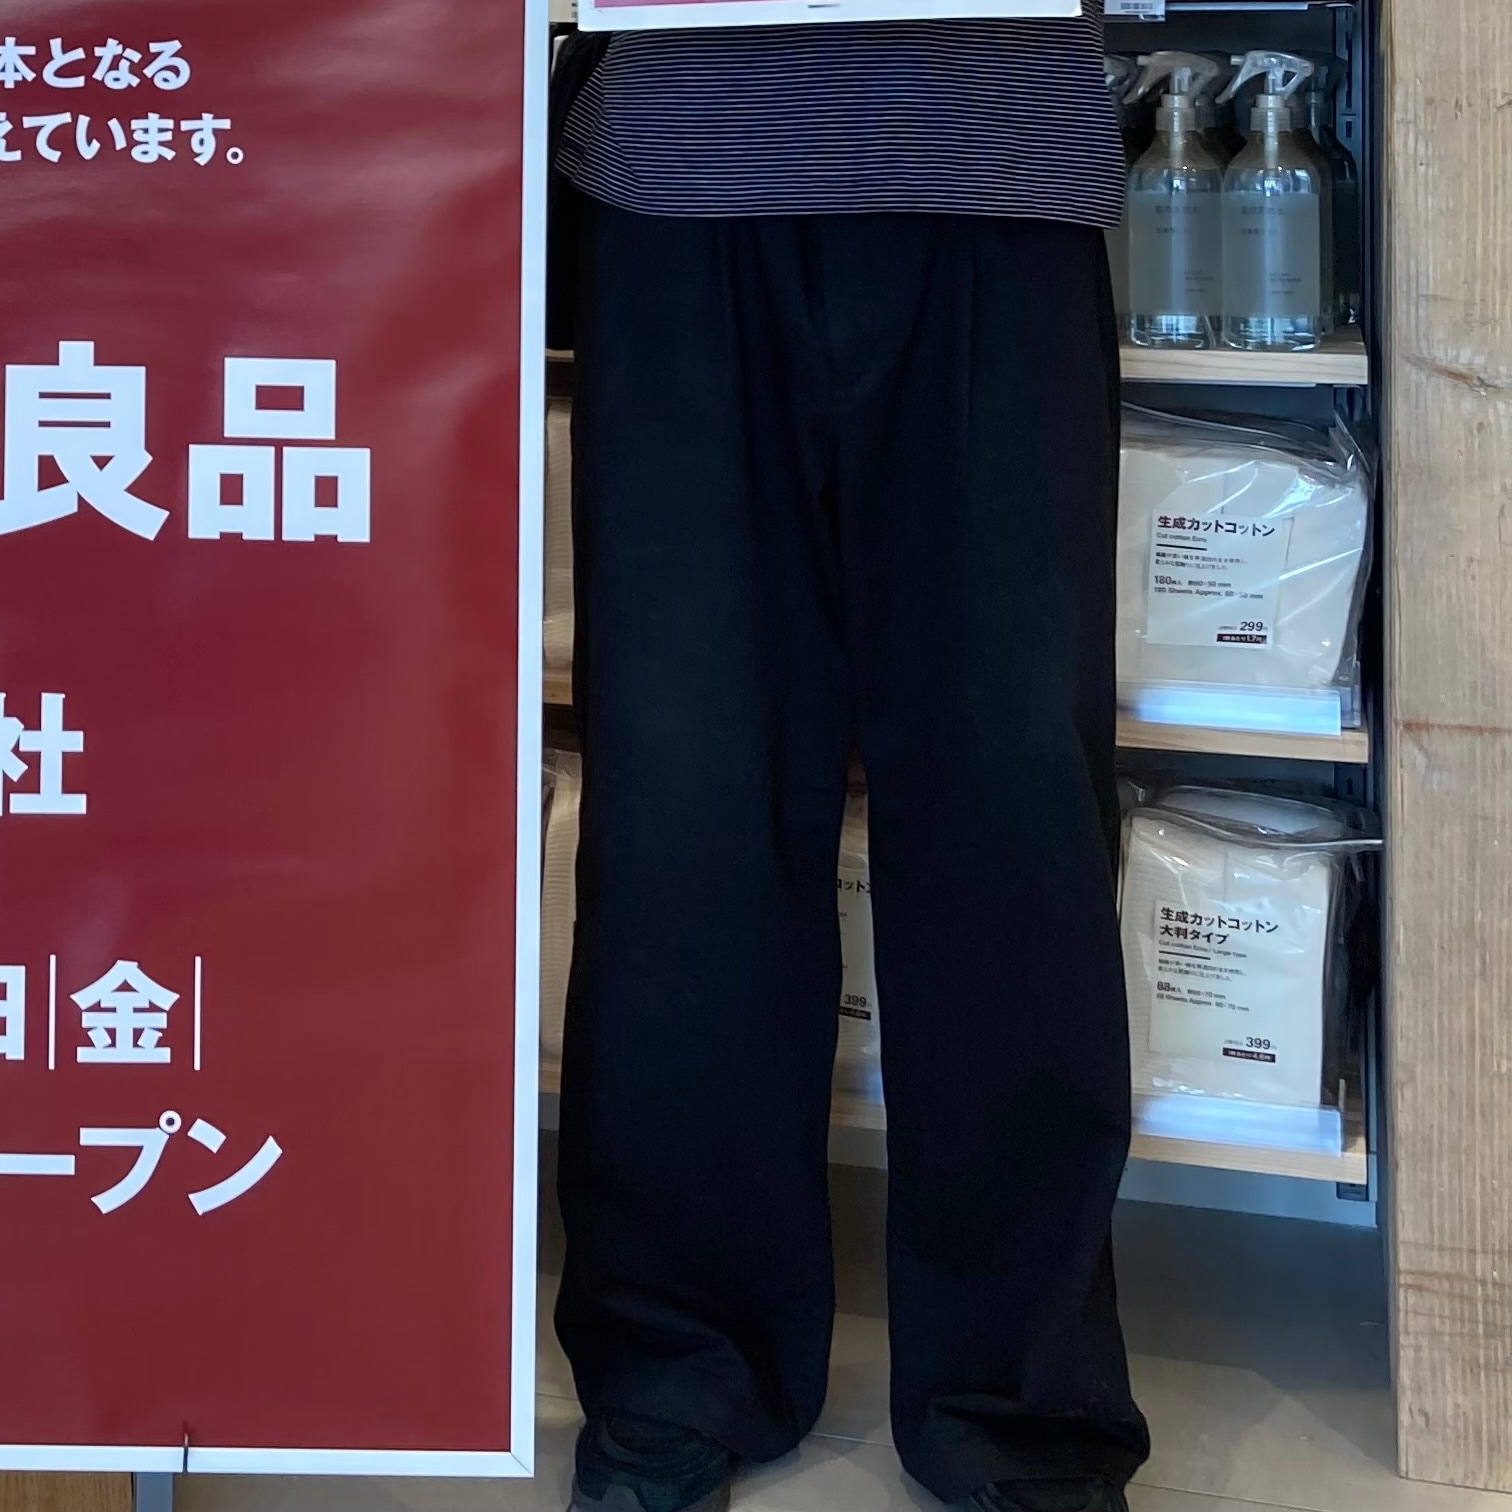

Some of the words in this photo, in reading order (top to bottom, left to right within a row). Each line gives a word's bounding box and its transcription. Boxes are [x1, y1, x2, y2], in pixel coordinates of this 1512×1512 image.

[1157, 516, 1276, 537] 生成カットコットン
[1160, 906, 1279, 934] 生成カットコットン
[1159, 925, 1230, 945] 大判タイプ
